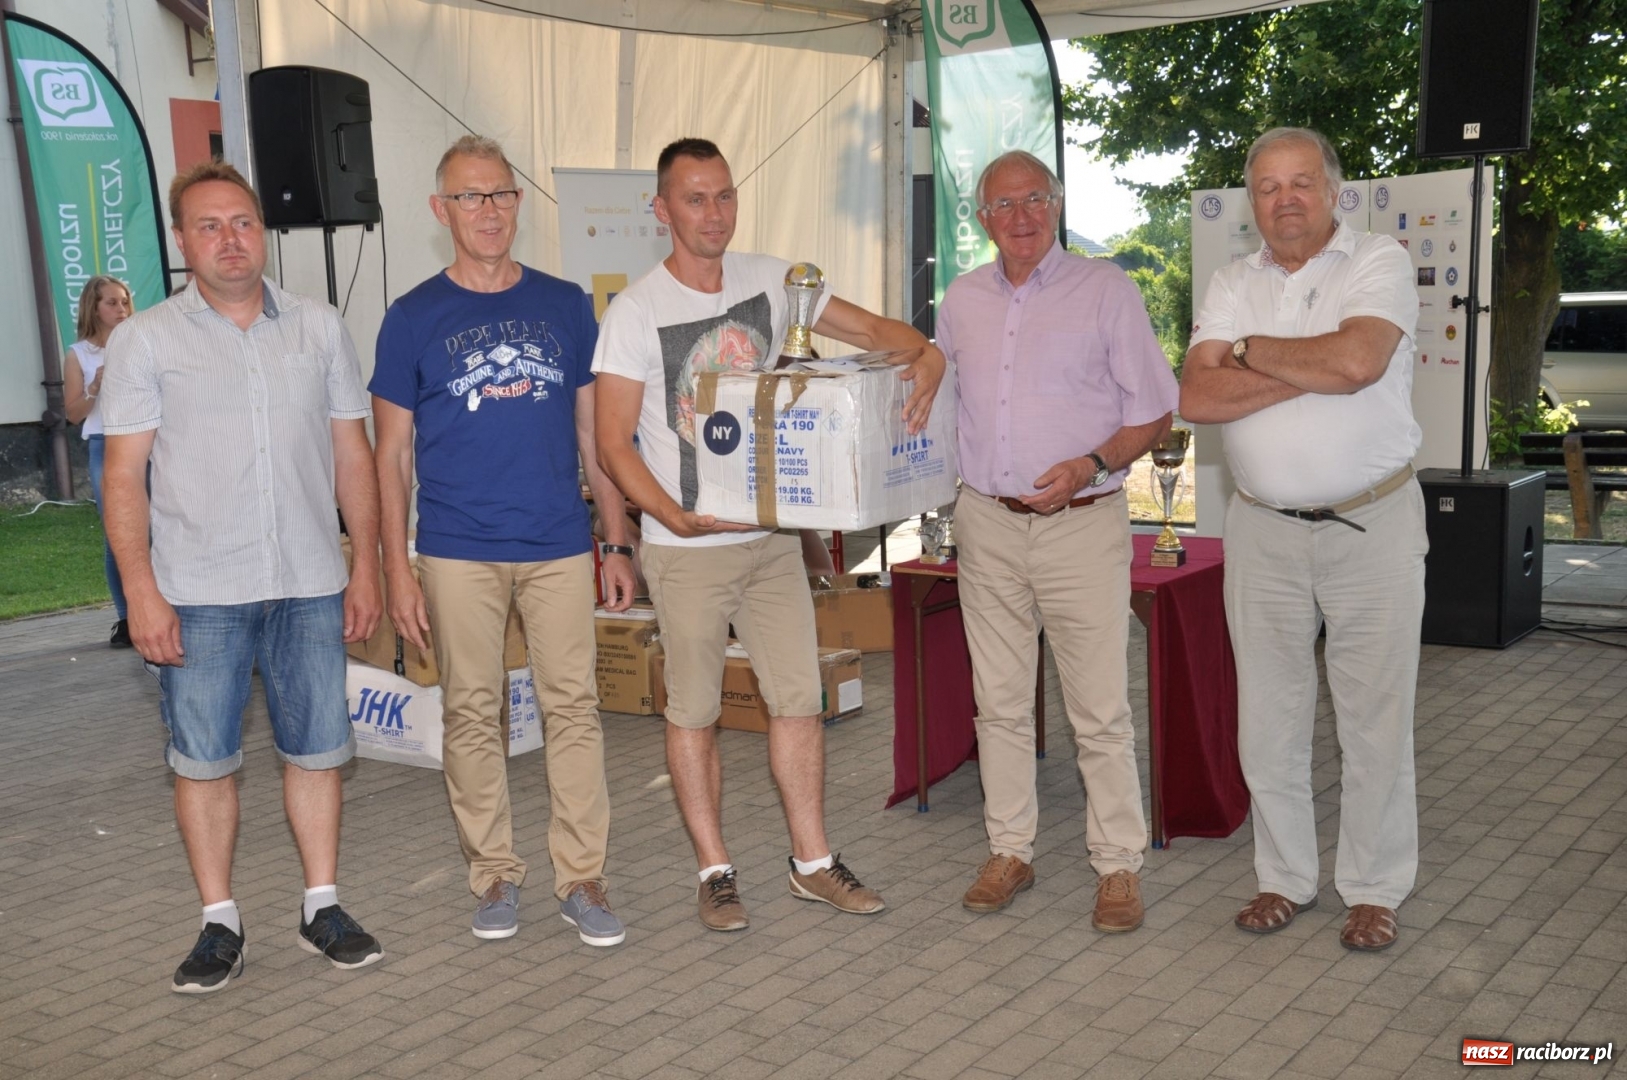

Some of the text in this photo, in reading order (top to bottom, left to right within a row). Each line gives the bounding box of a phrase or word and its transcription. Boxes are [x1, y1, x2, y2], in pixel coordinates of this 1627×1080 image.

[445, 324, 496, 372] PEPE
[452, 358, 564, 396] GENUINE AND AUTHENTIC
[485, 385, 511, 397] SINCE
[791, 409, 809, 420] T-SHIRT
[792, 421, 815, 431] 190
[713, 425, 733, 440] NY
[797, 459, 808, 467] PCS
[604, 667, 625, 675] MEDICAL
[721, 690, 758, 702] edman
[351, 687, 413, 730] JHK
[526, 712, 535, 722] US
[374, 726, 405, 738] T-SHIRT
